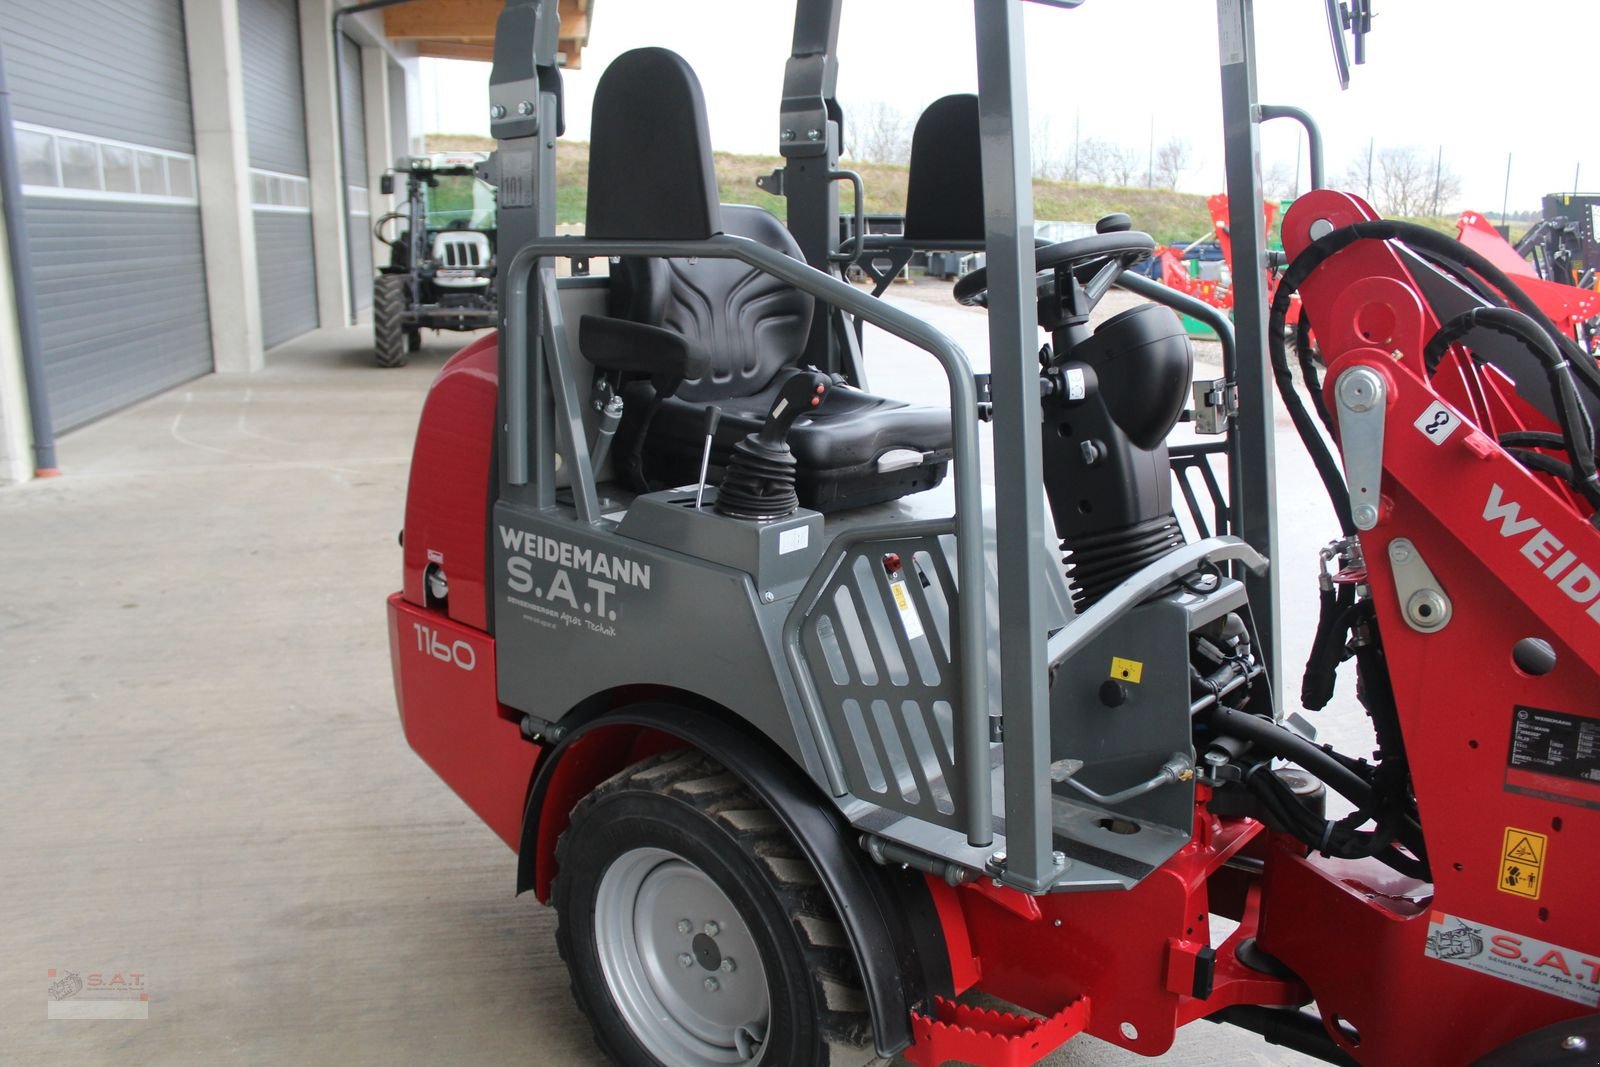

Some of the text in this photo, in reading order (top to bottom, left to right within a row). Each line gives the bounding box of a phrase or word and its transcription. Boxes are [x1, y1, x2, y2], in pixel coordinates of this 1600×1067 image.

[499, 525, 650, 590] WEIDEMANN
[507, 556, 617, 621] S.A.T.
[413, 623, 476, 671] 1160
